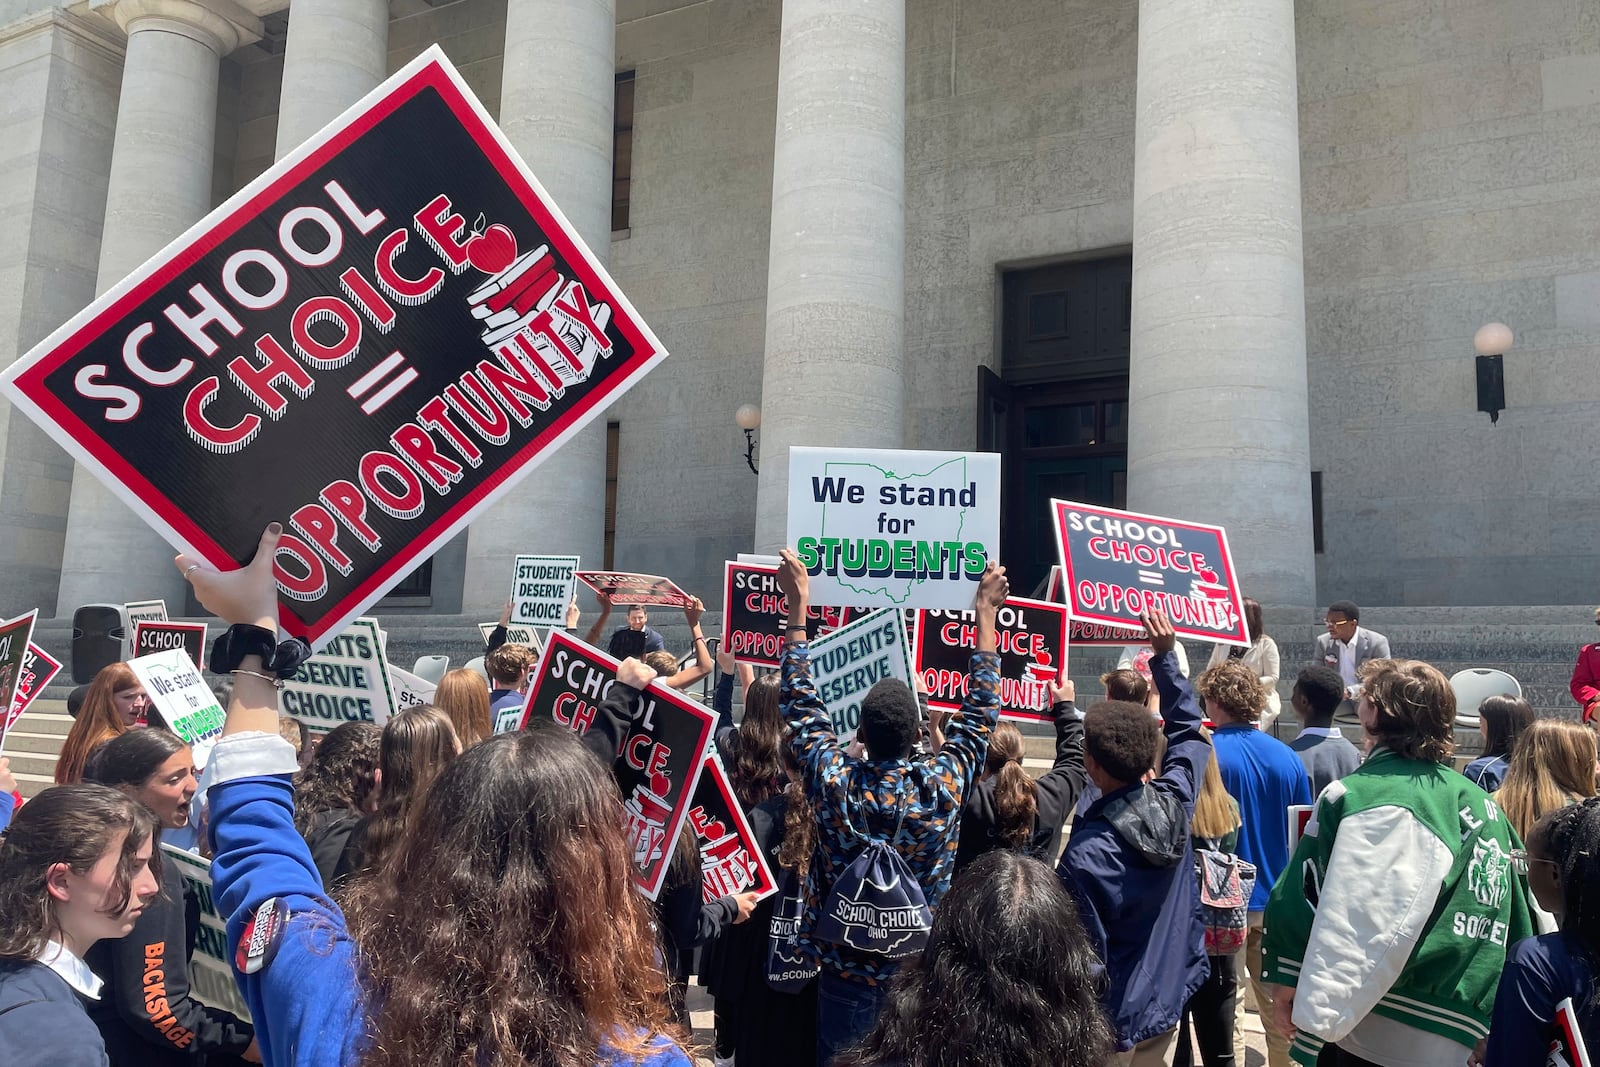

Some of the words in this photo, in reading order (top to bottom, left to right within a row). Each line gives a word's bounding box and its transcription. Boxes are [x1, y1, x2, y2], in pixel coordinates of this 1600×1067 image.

[74, 180, 386, 422] SCHOOL
[183, 194, 470, 454] CHOICE
[347, 350, 419, 416] =
[272, 281, 614, 603] OPPORTUNITY
[811, 476, 865, 504] We
[878, 482, 977, 508] stand
[877, 512, 916, 534] for
[1068, 512, 1183, 548] SCHOOL
[518, 565, 573, 580] STUDENTS
[797, 537, 988, 580] STUDENTS
[1088, 537, 1206, 574] CHOICE
[519, 583, 565, 598] DESERVE
[584, 575, 648, 584] SCHOOL
[735, 572, 784, 593] SCH
[520, 602, 562, 619] CHOICE
[746, 593, 836, 620] CHOCE
[930, 608, 1028, 629] CHOL
[1078, 579, 1236, 631] OPPORTUNITY
[141, 630, 186, 649] SCHOOL
[811, 619, 897, 680] TUDENTS
[941, 622, 1046, 657] CHICE
[149, 675, 174, 697] We
[174, 667, 201, 690] stand
[296, 661, 369, 690] SERVE
[551, 650, 656, 732] SCHL
[821, 655, 892, 705] ESERVE
[923, 667, 1055, 711] OPPUNIT
[184, 693, 199, 709] for
[282, 689, 375, 724] CHOICE
[400, 690, 431, 706] sta
[552, 692, 671, 779] CHCE
[837, 900, 877, 927] SCHOOL
[880, 910, 926, 928] CHOICE
[1453, 911, 1509, 948] SOCE
[250, 911, 264, 956] CHOICE
[868, 925, 888, 939] OHIO
[143, 941, 195, 1048] BACKSTAGE
